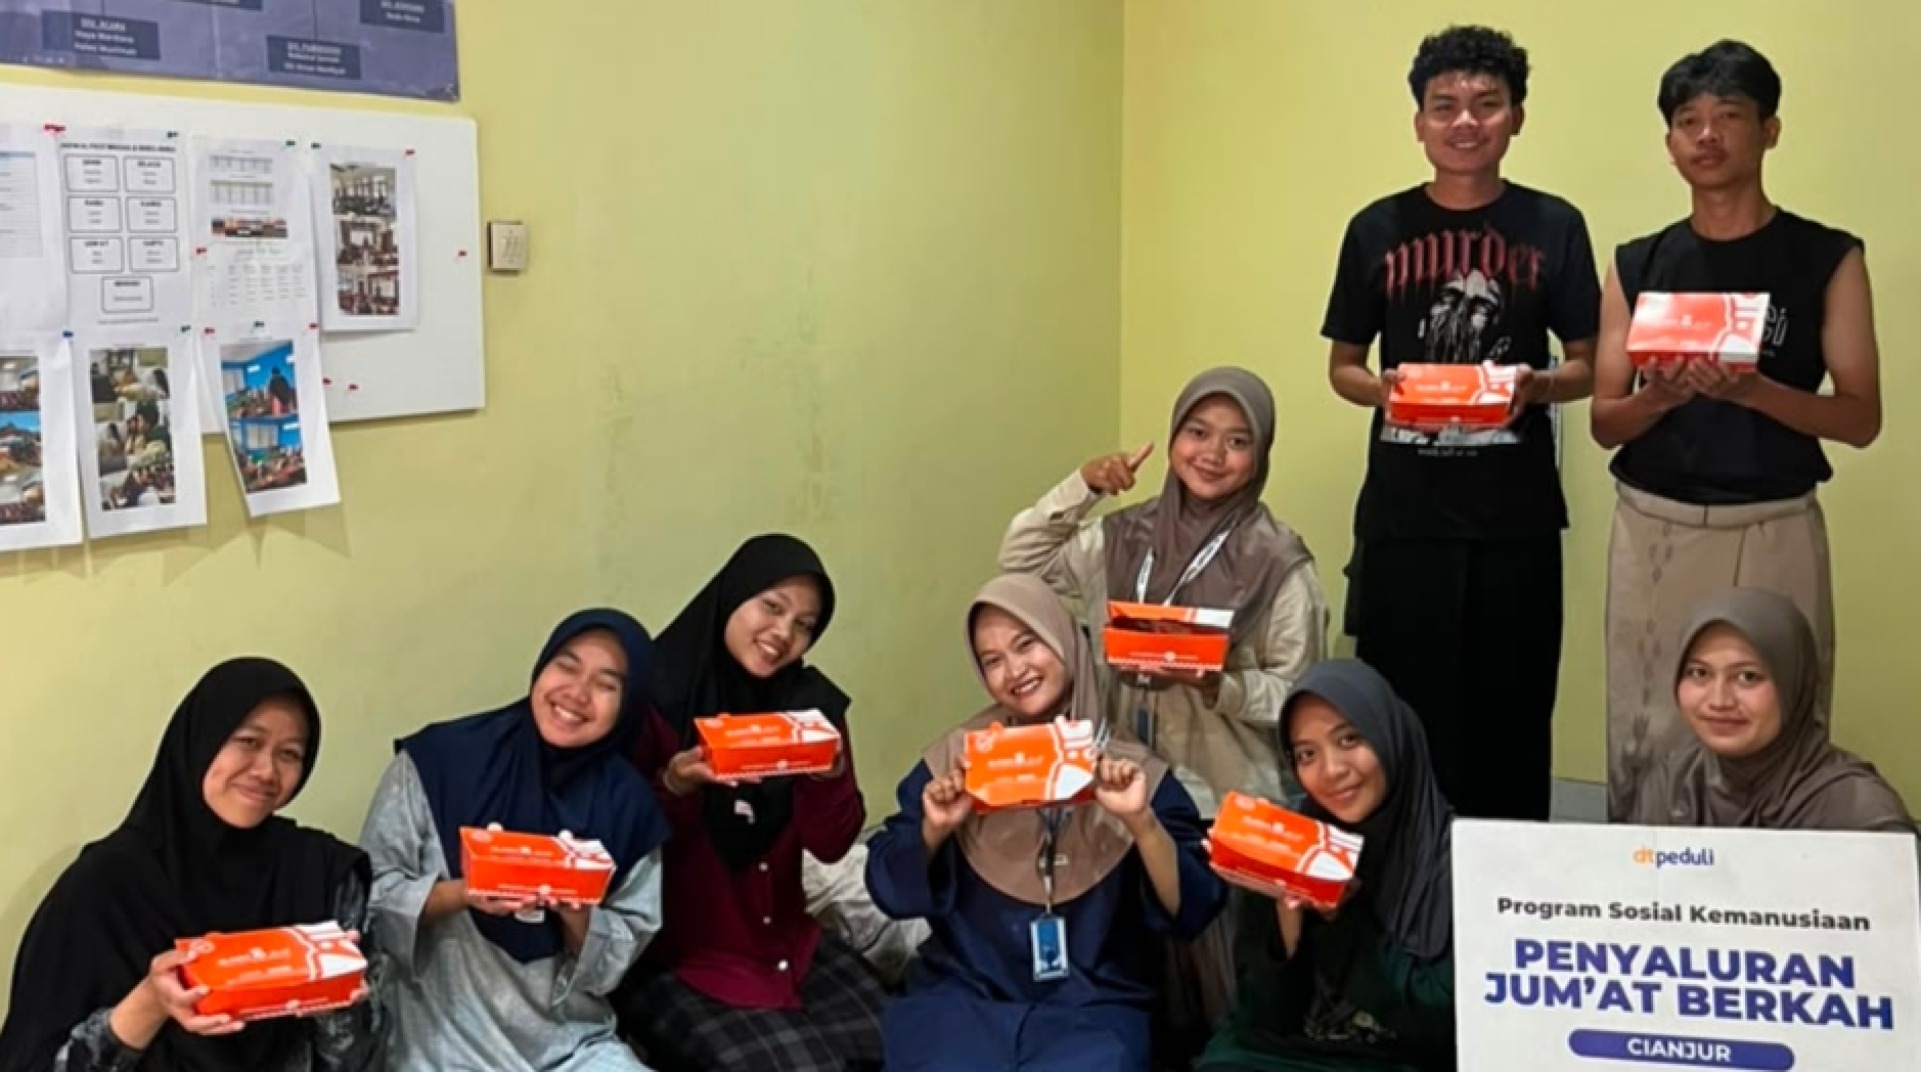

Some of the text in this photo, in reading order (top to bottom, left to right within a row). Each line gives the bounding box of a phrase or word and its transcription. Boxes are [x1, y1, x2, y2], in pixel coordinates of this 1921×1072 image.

[1497, 897, 1871, 931] Program Sosial Kemanusiaan
[1515, 938, 1855, 988] PENYALURAN
[1484, 972, 1894, 1029] JUM'AT BERKAH
[1627, 1037, 1731, 1062] CIANJUR
